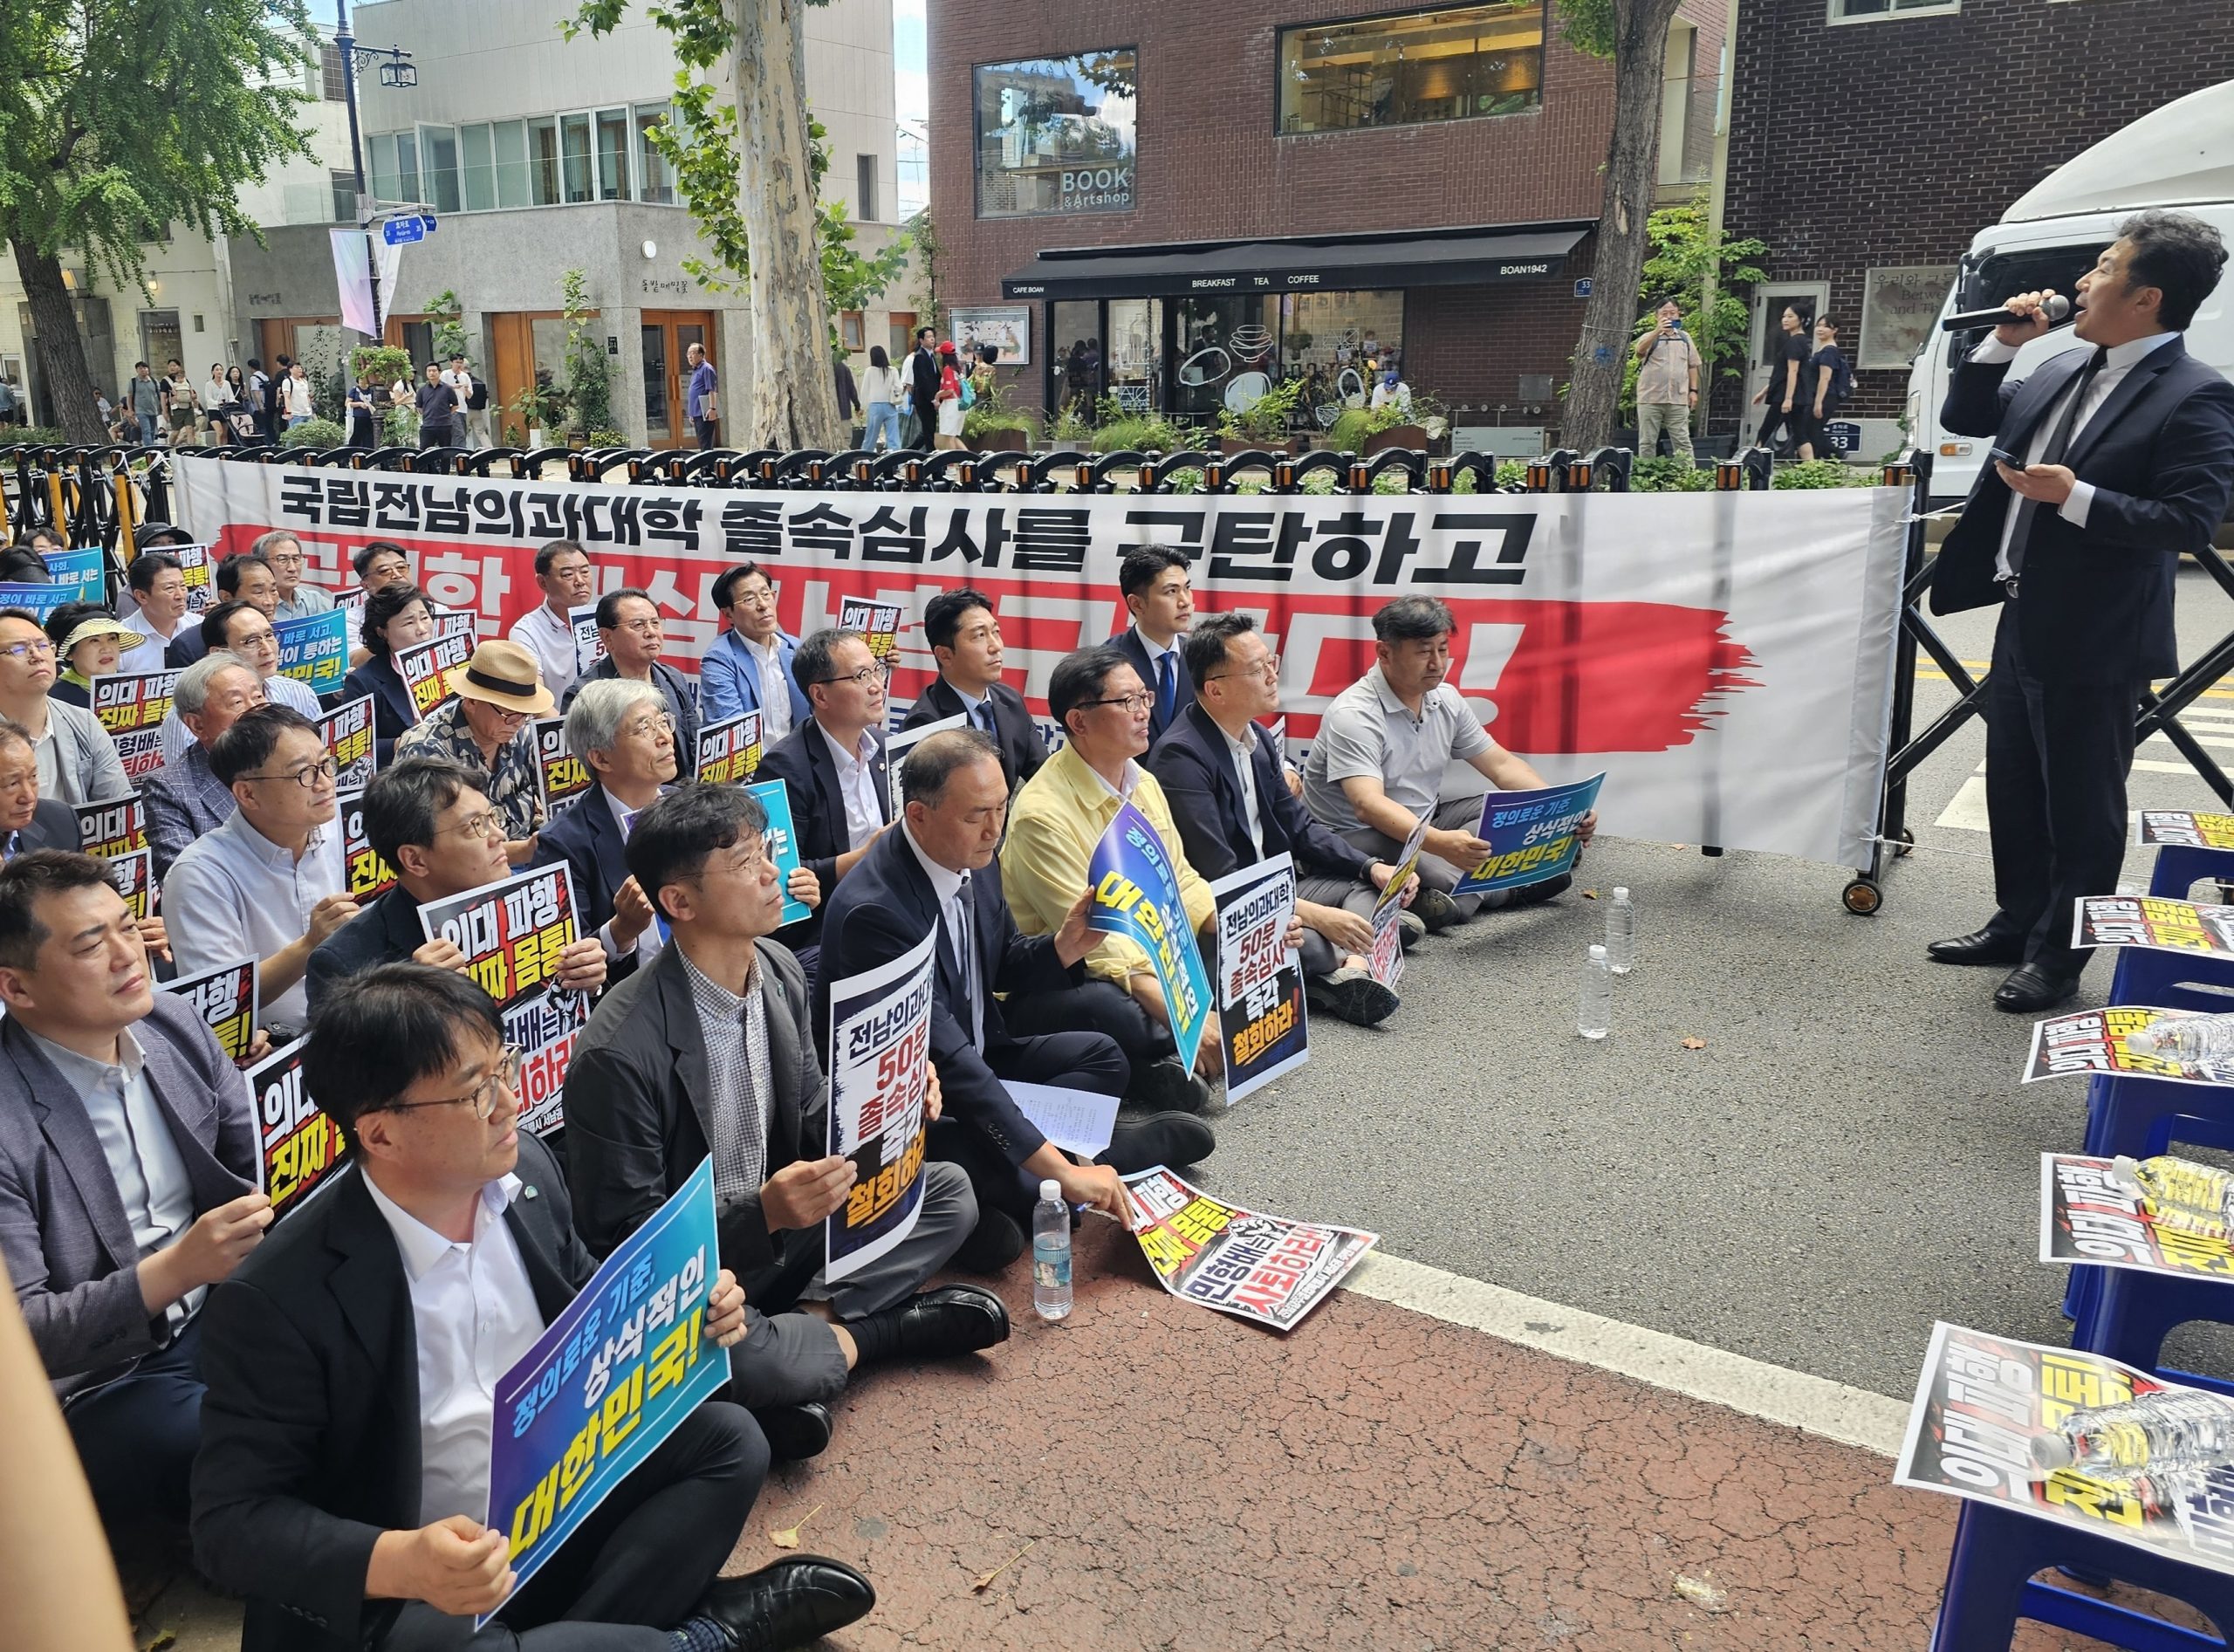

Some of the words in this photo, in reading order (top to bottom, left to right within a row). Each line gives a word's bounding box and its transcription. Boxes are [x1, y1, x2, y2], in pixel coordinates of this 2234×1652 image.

[1062, 167, 1129, 192] BOOK
[1065, 191, 1129, 208] &Artshop
[1191, 278, 1236, 288] BREAKFAST
[1253, 277, 1269, 286] TEA
[1287, 274, 1320, 284] COFFEE
[1500, 264, 1548, 275] BOAN1942
[1581, 280, 1591, 289] 33
[1873, 272, 1921, 290] 우리와
[1890, 303, 1915, 315] and
[1921, 303, 1939, 314] Th
[1902, 290, 1944, 301] Betwe
[1830, 436, 1849, 449] 33
[280, 475, 699, 552] 국립전남의과대학
[720, 497, 1092, 572] 졸속심사를
[58, 572, 79, 585] 바로
[24, 594, 48, 605] 바로
[841, 607, 871, 632] 의대
[870, 607, 898, 632] 파행
[284, 629, 306, 645] 바로
[303, 635, 343, 661] 통하는
[277, 657, 341, 684] 민국!
[405, 649, 435, 685] 의대
[435, 637, 467, 668] 파행
[96, 679, 140, 707] 의대
[414, 677, 442, 710] 진짜
[99, 703, 140, 730] 진짜
[334, 702, 367, 742] 파행
[337, 725, 373, 767] 몸통!
[543, 730, 572, 761] 의
[700, 730, 730, 766] 의대
[731, 716, 757, 752] 파행
[80, 805, 127, 846] 의대
[1492, 803, 1543, 829] 정의로운
[113, 857, 138, 896] 행
[1470, 836, 1572, 881] 대한민국!
[441, 899, 500, 963] 의대
[504, 873, 560, 942] 파행
[1225, 881, 1291, 939] 전남의과대학
[2084, 899, 2143, 922] 파행
[1239, 918, 1278, 965] 50분
[2091, 919, 2150, 945] 의대
[2148, 923, 2213, 952] 진짜
[463, 952, 508, 1001] 짜
[1230, 939, 1286, 997] 졸속심사
[1245, 977, 1281, 1022] 즉각
[215, 1010, 251, 1061] 통!
[505, 1005, 561, 1055] 배는
[1232, 986, 1300, 1065] 철회하라!
[2044, 1017, 2104, 1047] 파행
[875, 1015, 928, 1091] 50분
[2047, 1041, 2113, 1073] 의대
[270, 1112, 329, 1209] 진짜
[1133, 1173, 1189, 1220] 파행
[1138, 1226, 1196, 1278] 진짜
[1168, 1196, 1239, 1246] 몸통!
[2066, 1209, 2155, 1266] 의대
[1185, 1233, 1277, 1299] 민형배는
[513, 1307, 603, 1439] 정의로운
[606, 1251, 656, 1326] 기준,
[582, 1244, 706, 1409] 상식적인
[1944, 1340, 2034, 1428] 파행
[508, 1306, 703, 1564] 대한민국!
[1939, 1408, 2034, 1504] 의대
[2045, 1466, 2144, 1531] 진
